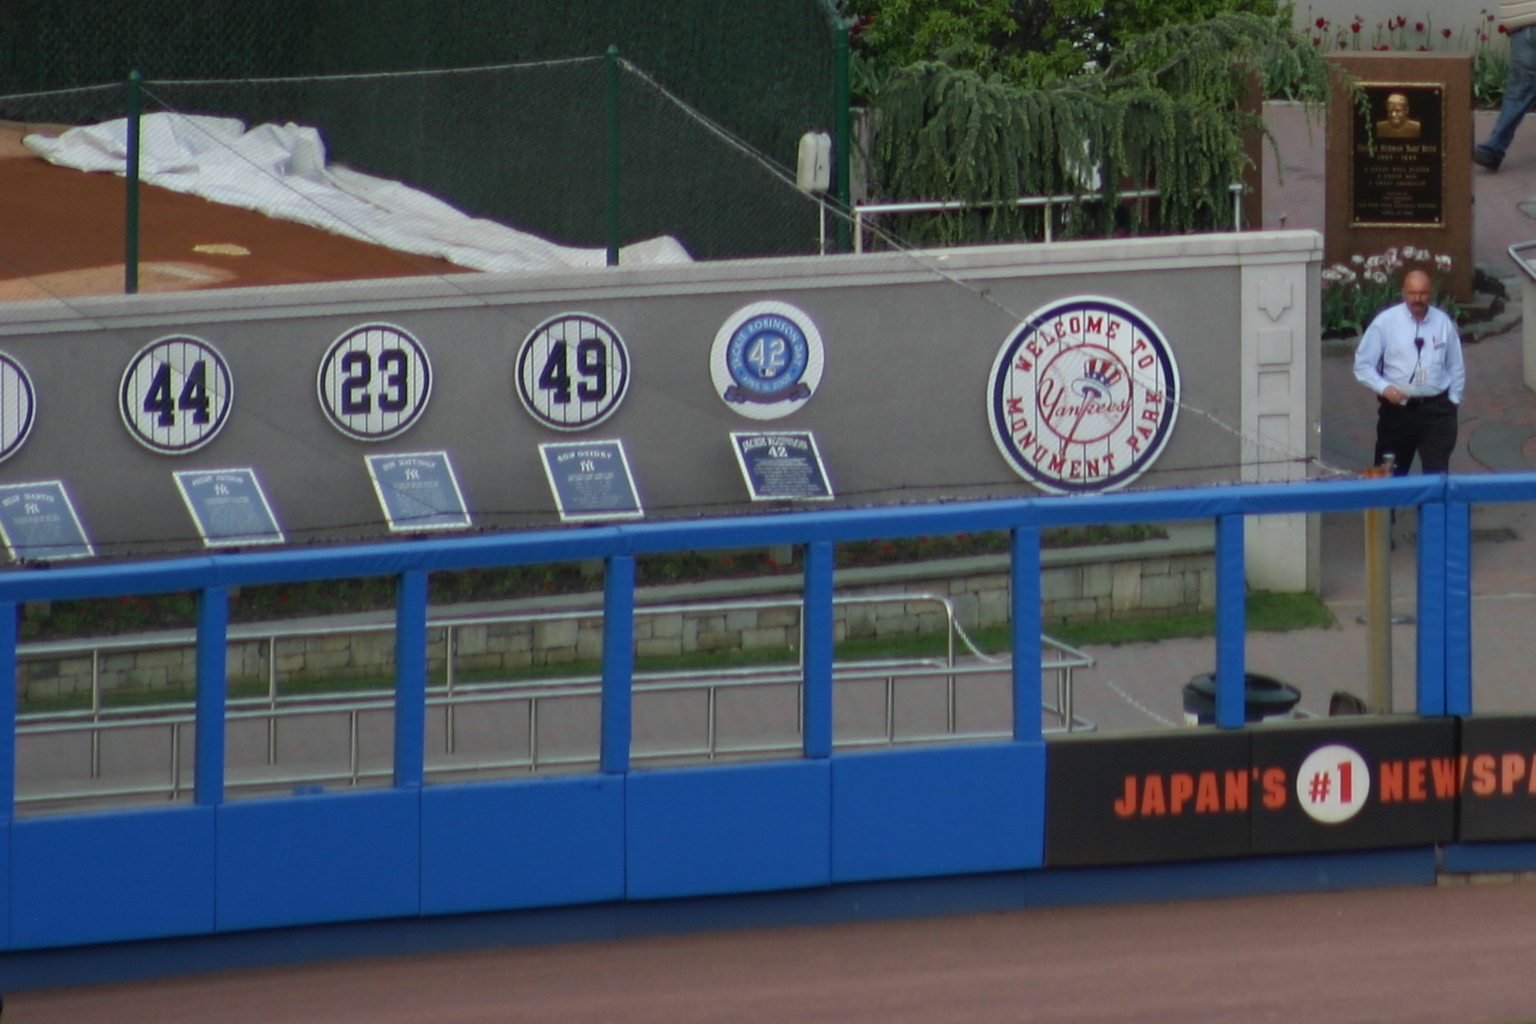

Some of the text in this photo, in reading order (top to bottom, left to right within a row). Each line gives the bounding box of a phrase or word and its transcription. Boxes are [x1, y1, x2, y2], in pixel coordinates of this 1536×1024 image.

[732, 317, 805, 369] JACKIE ROBINSON DAY
[748, 338, 785, 367] 42
[1015, 315, 1155, 373] WELCOME TO
[143, 360, 210, 427] 44
[341, 348, 408, 415] 23
[539, 338, 607, 405] 49
[1039, 377, 1132, 424] Yankees
[557, 451, 575, 462] RON
[767, 446, 788, 458] 42
[1006, 388, 1163, 479] MONUMENT PARK
[24, 492, 55, 503] MARTIN
[1113, 767, 1288, 818] JAPAN'S
[1308, 759, 1353, 805] #1
